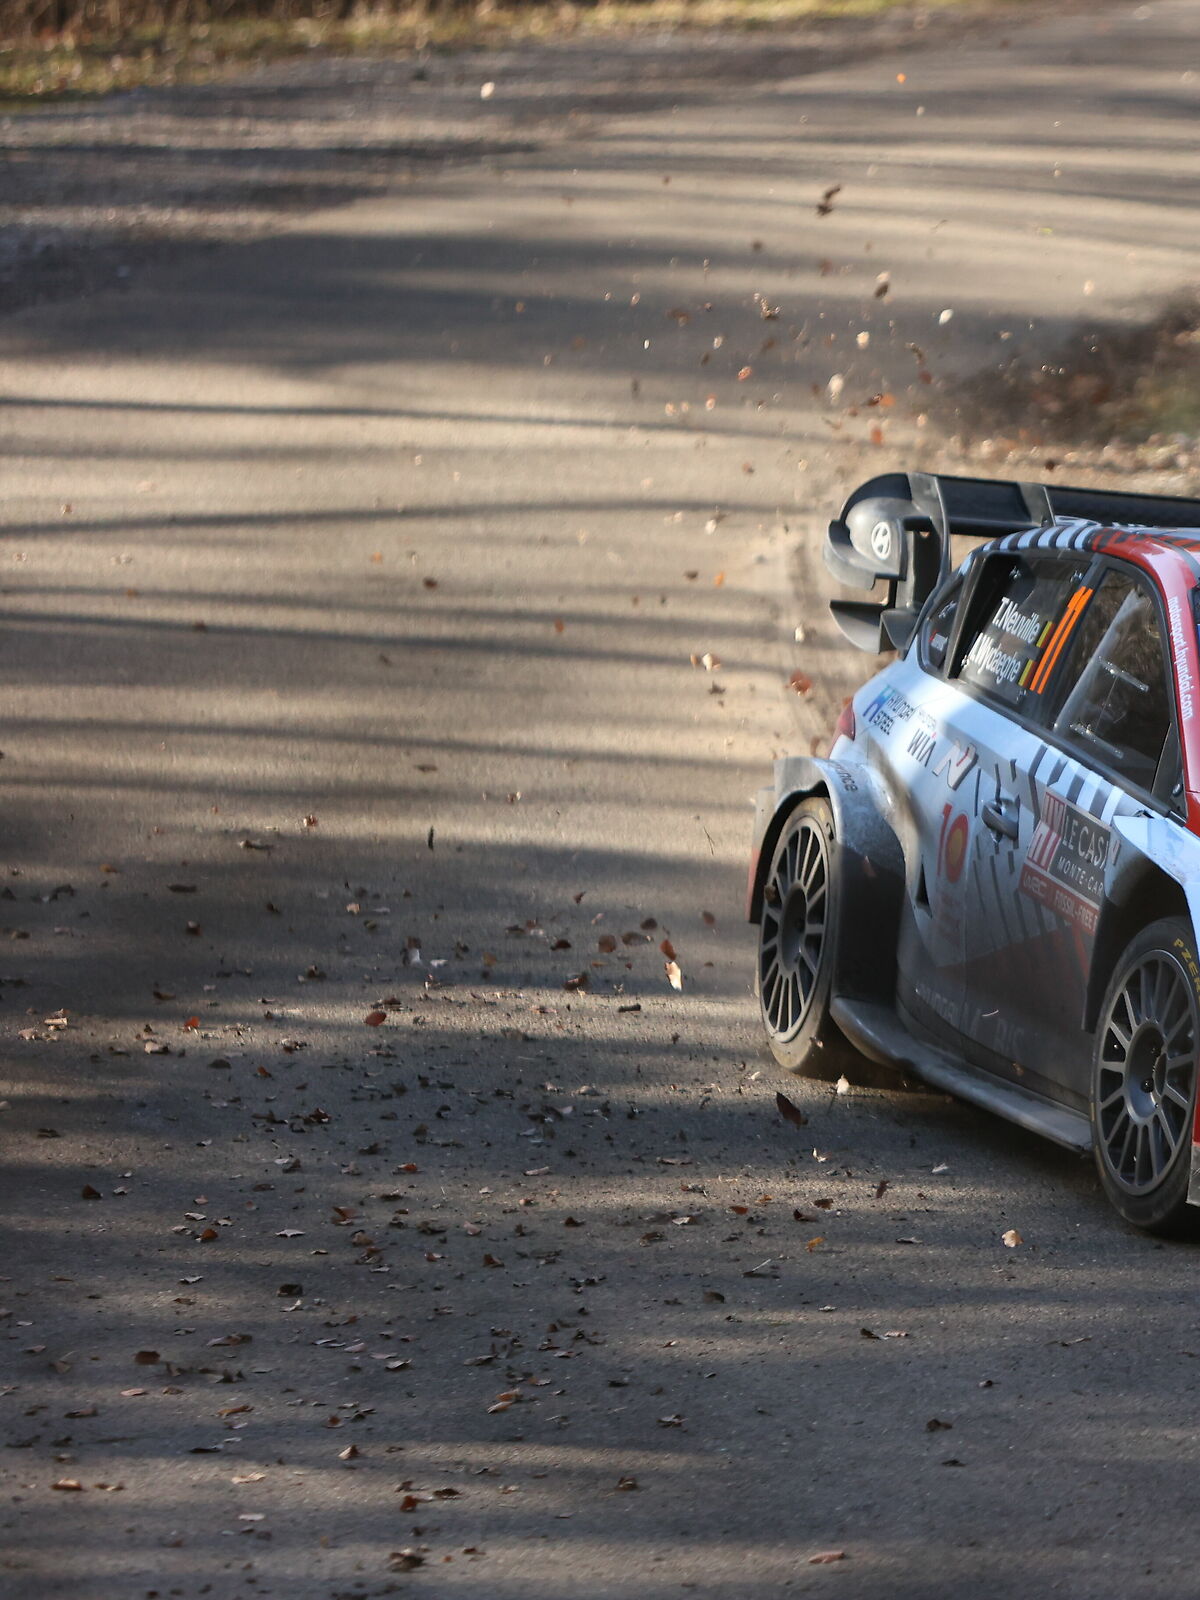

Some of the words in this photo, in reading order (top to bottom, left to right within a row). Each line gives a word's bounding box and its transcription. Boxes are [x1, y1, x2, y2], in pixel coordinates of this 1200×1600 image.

[1167, 596, 1195, 721] motorsport.hyundai.com
[873, 710, 895, 736] STEEL
[907, 727, 937, 768] WIA
[1062, 815, 1079, 851] LE
